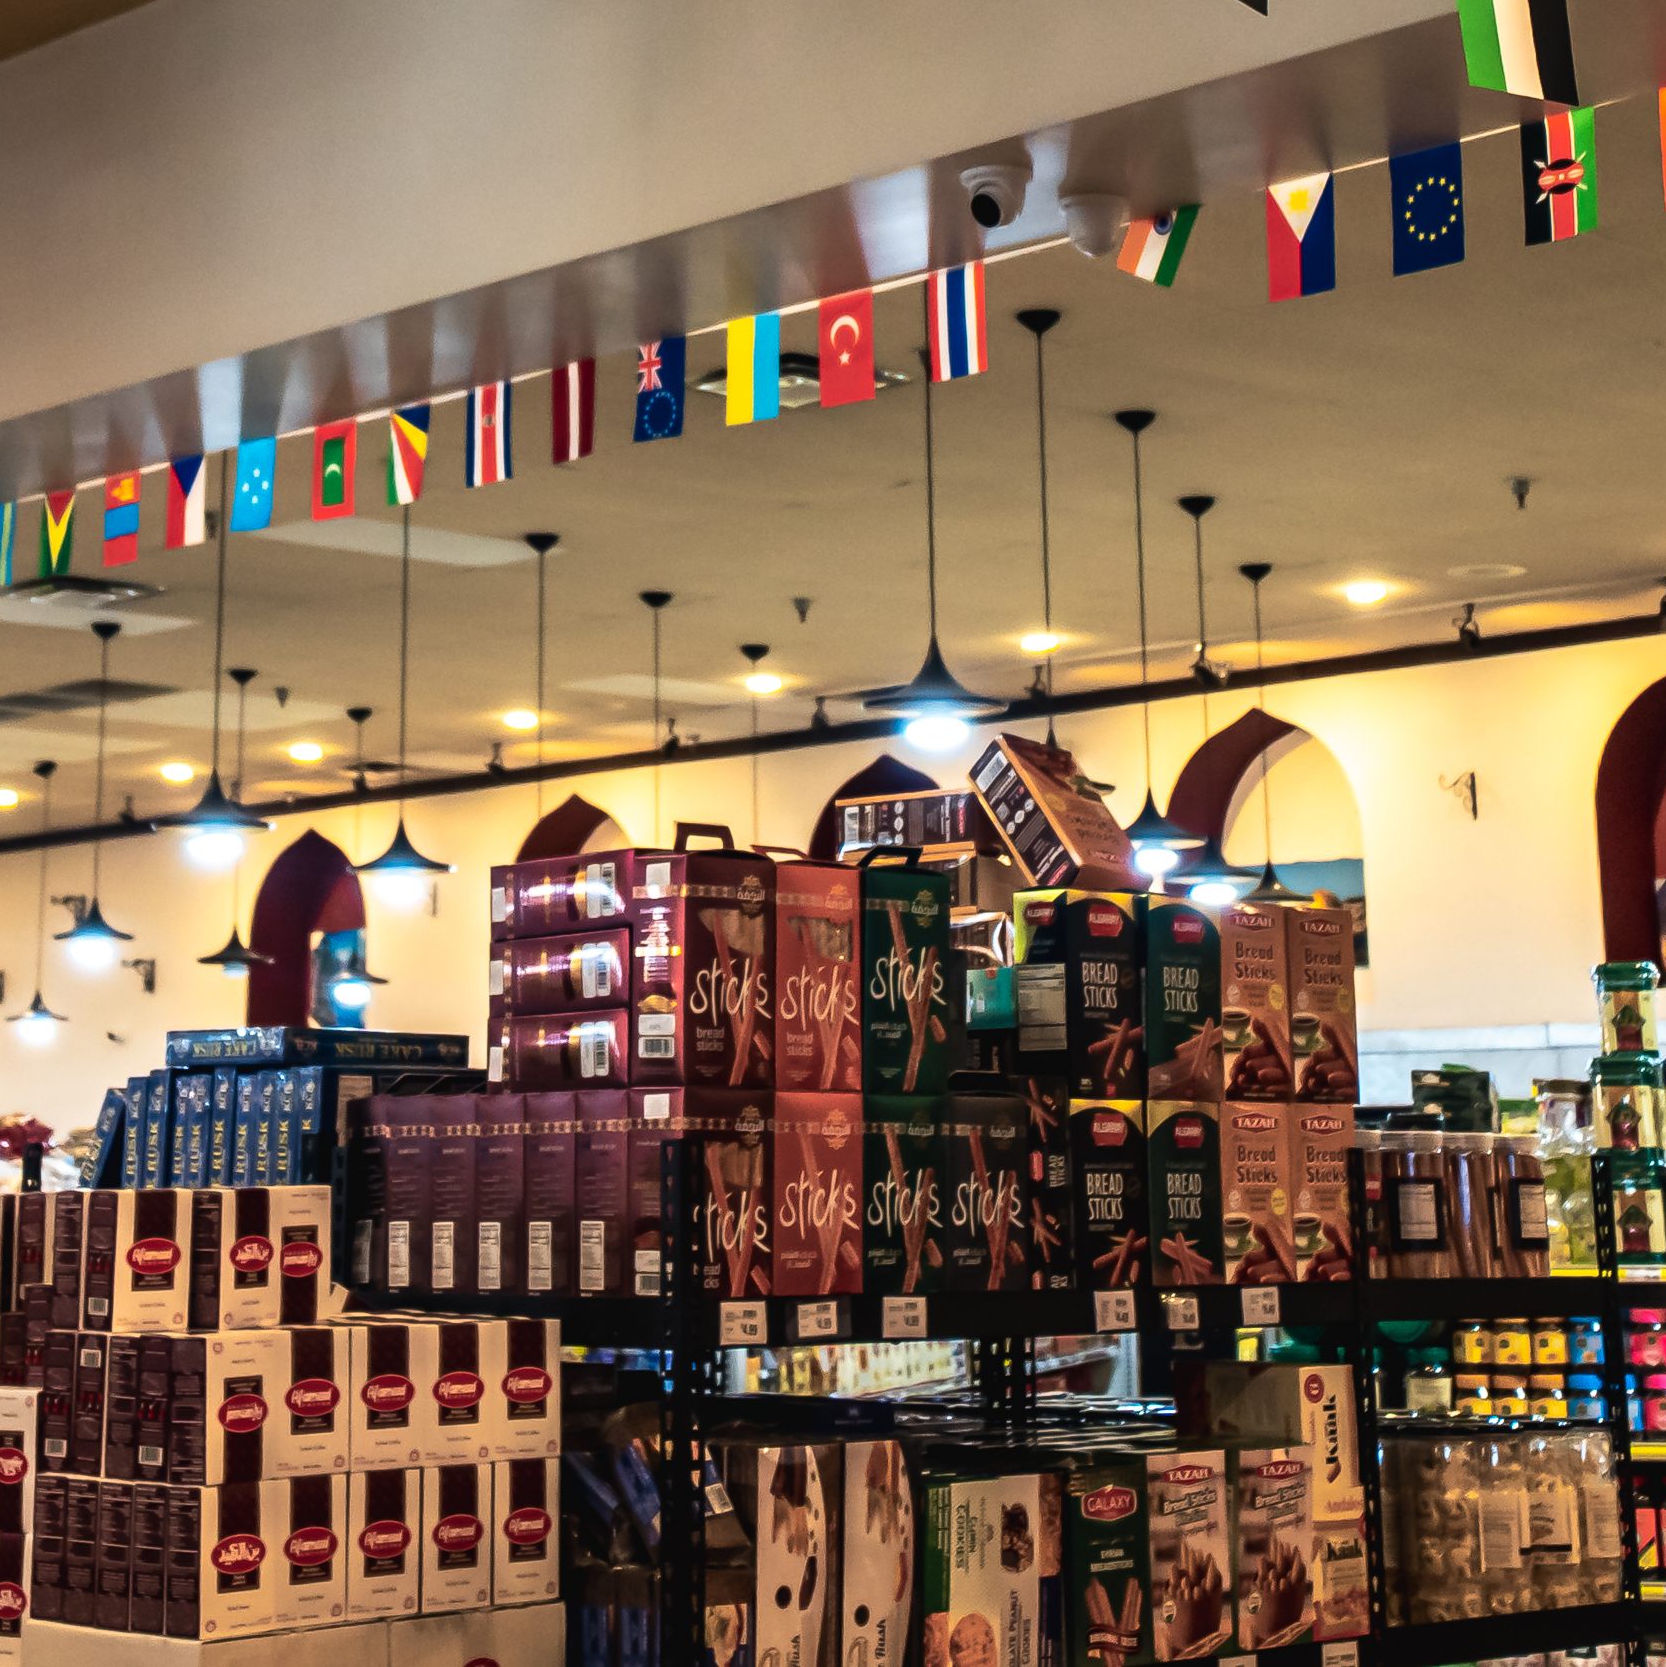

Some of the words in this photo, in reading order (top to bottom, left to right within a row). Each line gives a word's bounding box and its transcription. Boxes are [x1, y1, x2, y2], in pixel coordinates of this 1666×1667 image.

[1235, 941, 1274, 961] Bread
[1304, 947, 1342, 966] Bread
[870, 946, 948, 1012] sticks
[1081, 962, 1118, 985] BREAD
[1163, 966, 1200, 990] BREAD
[1234, 964, 1276, 981] Sticks
[1304, 968, 1345, 987] Sticks
[689, 957, 772, 1027] sticks
[780, 965, 861, 1031] sticks
[1083, 986, 1118, 1009] STICKS
[1164, 991, 1199, 1013] STICKS
[696, 1026, 725, 1039] bread
[786, 1032, 814, 1045] bread
[335, 1040, 375, 1059] RUSK
[382, 1043, 422, 1061] CAKE
[696, 1039, 724, 1052] sticks
[1235, 1116, 1276, 1130] TAZAH
[1304, 1118, 1344, 1132] TAZAH
[1237, 1145, 1276, 1163] Bread
[1306, 1146, 1345, 1163] Bread
[1166, 1173, 1202, 1195] BREAD
[1236, 1165, 1279, 1184] Sticks
[1306, 1166, 1347, 1185] Sticks
[1086, 1173, 1124, 1196] BREAD
[779, 1169, 860, 1240] sticks
[867, 1169, 944, 1237] sticks
[951, 1169, 1025, 1237] sticks
[1088, 1198, 1124, 1221] STICKS
[1167, 1198, 1202, 1220] STICKS
[693, 1190, 771, 1263] ticks
[1169, 1467, 1209, 1482] TAZAH
[1260, 1462, 1303, 1477] TAZAH
